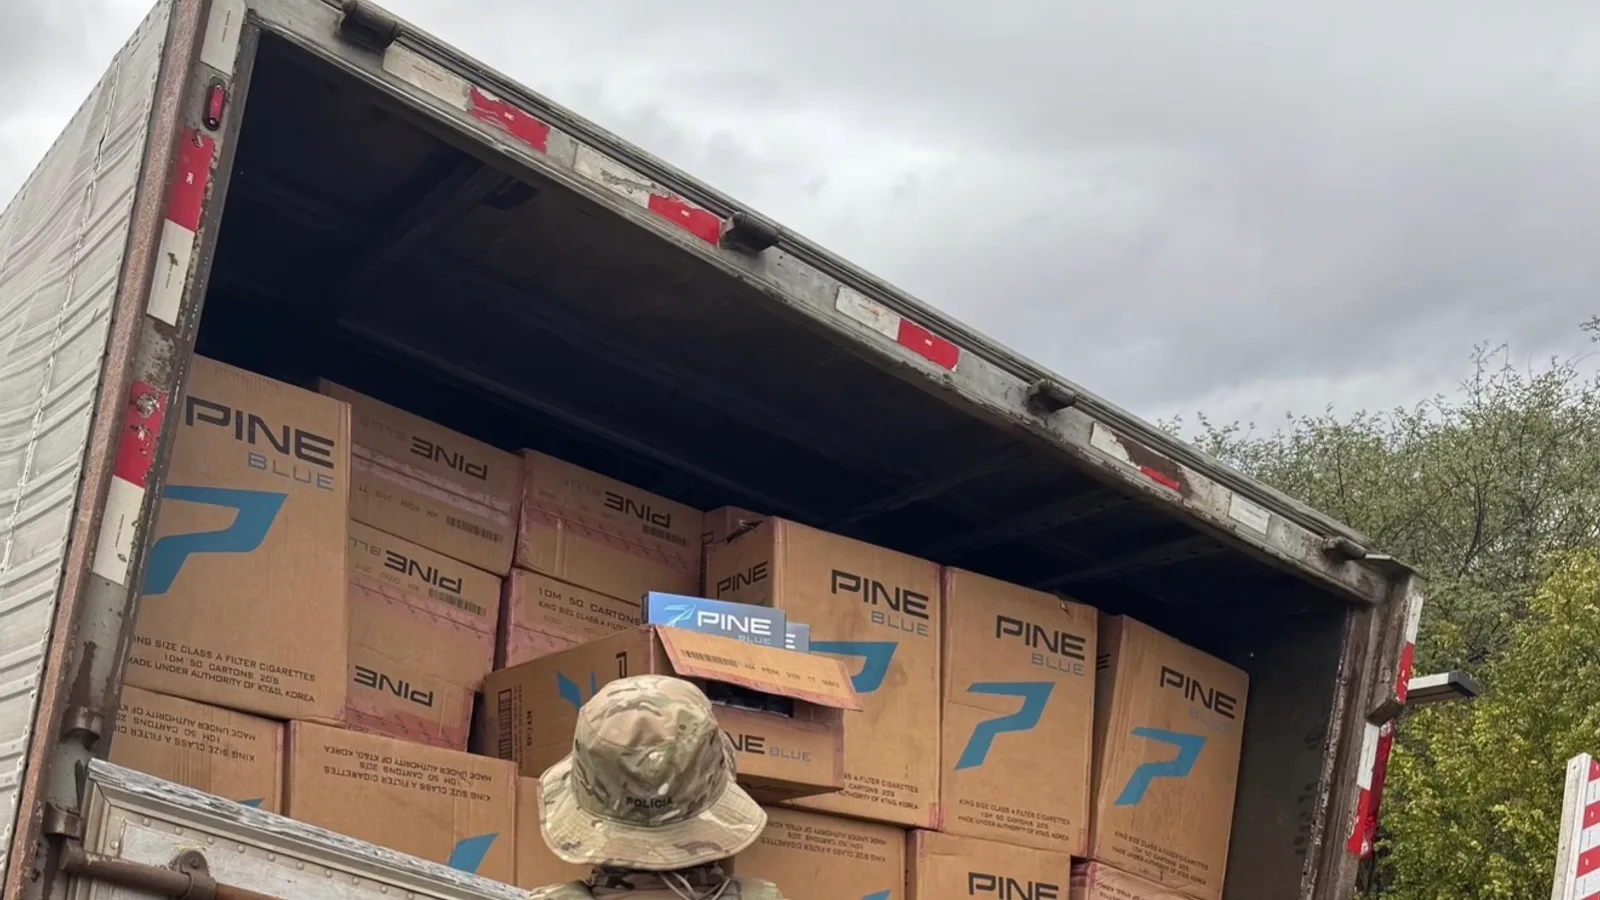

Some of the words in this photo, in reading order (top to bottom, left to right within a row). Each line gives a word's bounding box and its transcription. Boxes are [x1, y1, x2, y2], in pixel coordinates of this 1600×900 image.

[185, 395, 335, 470] PINE
[410, 436, 488, 481] PINE
[248, 451, 335, 492] BLUE
[603, 490, 671, 529] PINE
[384, 550, 463, 594] PINE
[717, 561, 768, 599] PINE
[831, 568, 929, 620] PINE
[538, 587, 561, 601] 10M
[568, 597, 584, 608] 50
[590, 603, 640, 626] CARTONS
[538, 601, 557, 611] KING
[559, 606, 574, 617] SIZE
[697, 610, 772, 636] PINE
[871, 610, 929, 637] BLUE
[738, 634, 771, 645] BLUE
[995, 614, 1086, 661] PINE
[133, 635, 152, 646] ING
[155, 639, 177, 652] SIZE
[180, 644, 213, 660] CLASS
[215, 653, 223, 661] A
[225, 655, 257, 669] FILTER
[259, 662, 316, 682] CIGARETTES
[164, 653, 184, 665] 10M
[190, 661, 203, 669] 50
[208, 663, 254, 679] CARTONS
[1031, 652, 1085, 677] BLUE
[155, 661, 188, 676] UNDER
[190, 669, 241, 687] AUTHORITY
[243, 681, 256, 689] OF
[285, 690, 315, 703] KOREA
[353, 664, 434, 708] PINE
[1160, 665, 1237, 720] PINE
[131, 706, 144, 716] OF
[145, 710, 196, 728] AUTHORITY
[133, 717, 178, 734] CARTONS
[198, 722, 229, 735] UNDER
[1188, 706, 1235, 735] BLUE
[130, 728, 162, 742] FILTER
[184, 728, 197, 738] 50
[203, 733, 220, 744] 10M
[231, 728, 256, 741] MADE
[174, 737, 205, 752] CLASS
[208, 745, 229, 757] SIZE
[324, 745, 354, 757] KOREA
[725, 731, 765, 755] NE
[769, 746, 813, 762] BLUE
[231, 751, 255, 762] KING
[381, 756, 393, 764] OF
[383, 765, 424, 780] CARTONS
[394, 758, 438, 773] AUTHORITY
[440, 767, 468, 778] UNDER
[324, 765, 379, 783] CIGARETTES
[381, 776, 409, 788] FILTER
[427, 774, 439, 782] 50
[470, 772, 492, 782] MADE
[411, 781, 417, 789] A
[419, 783, 447, 795] CLASS
[450, 788, 468, 798] SIZE
[881, 779, 919, 794] CIGARETTES
[470, 791, 491, 801] KING
[968, 872, 1059, 900] PINE
